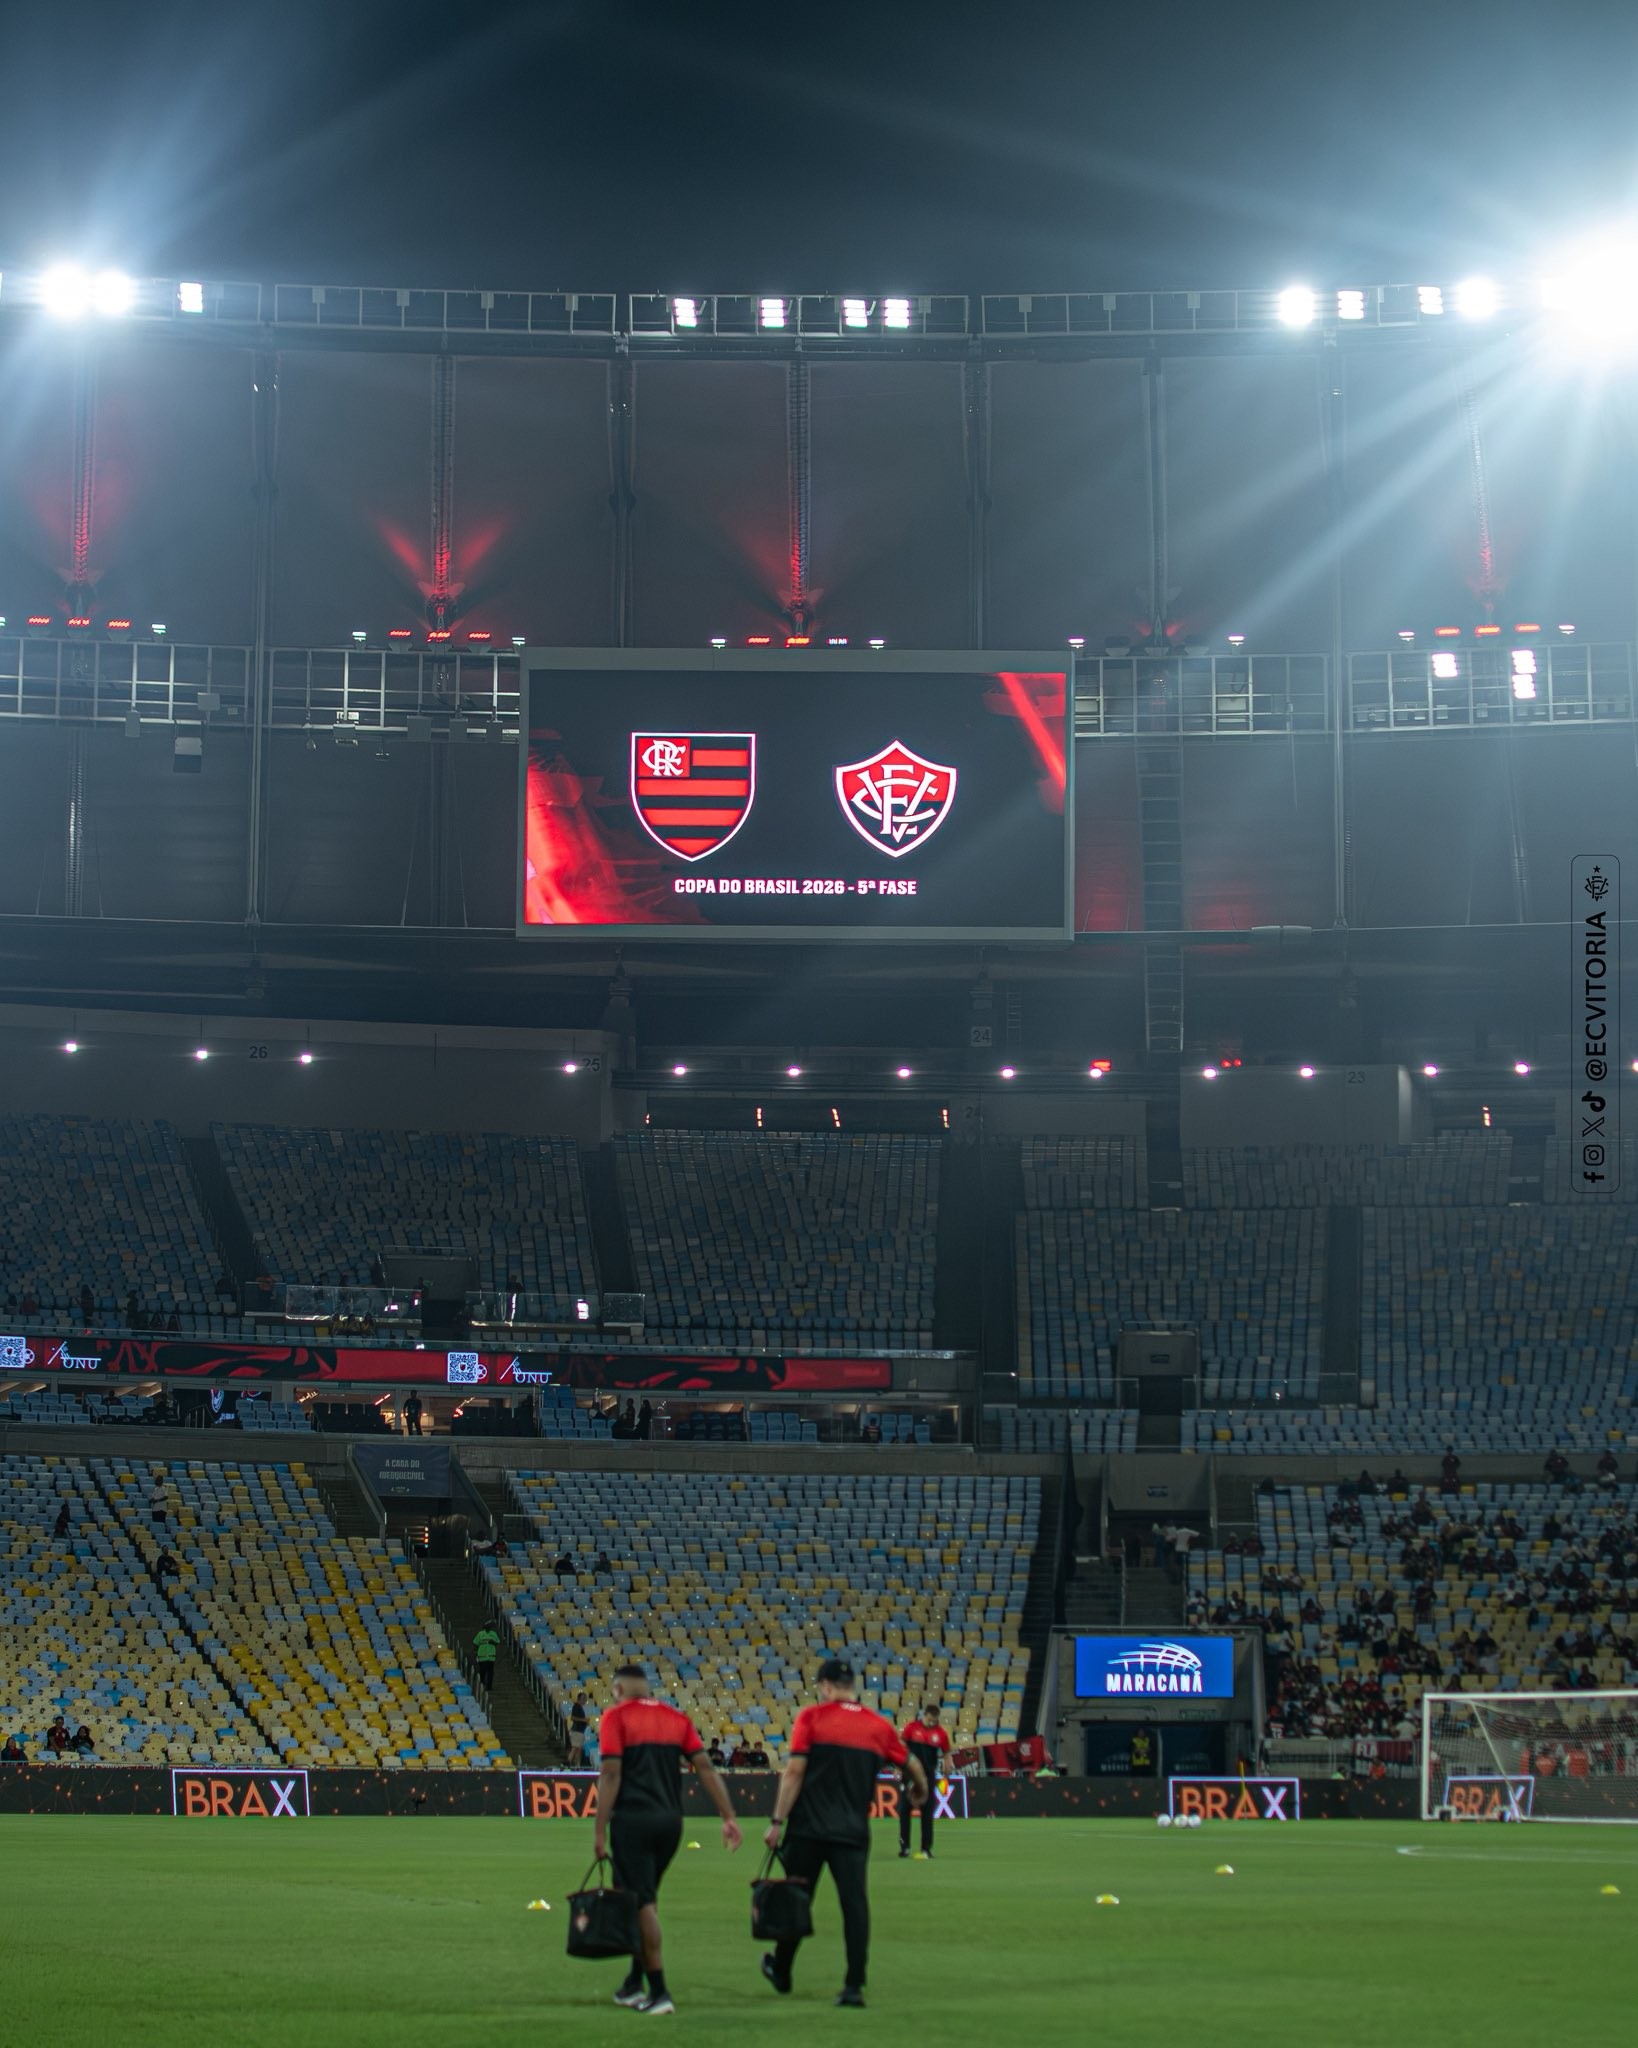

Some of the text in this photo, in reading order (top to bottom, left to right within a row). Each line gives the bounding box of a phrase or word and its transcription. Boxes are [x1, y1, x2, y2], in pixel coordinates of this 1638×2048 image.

[674, 879, 716, 894] COPA
[719, 879, 741, 894] DO
[744, 879, 800, 894] BRASIL
[802, 880, 845, 895] 2026
[857, 880, 876, 895] 5ª
[879, 880, 917, 895] FASE
[972, 1029, 993, 1043] 24
[248, 1045, 268, 1059] 26
[582, 1057, 600, 1072] 25
[1106, 1670, 1203, 1693] MARACANÃ
[185, 1779, 297, 1817] BRAX
[531, 1781, 599, 1818] BRA
[1181, 1785, 1288, 1821] BRAX
[1453, 1785, 1525, 1823] BRAX
